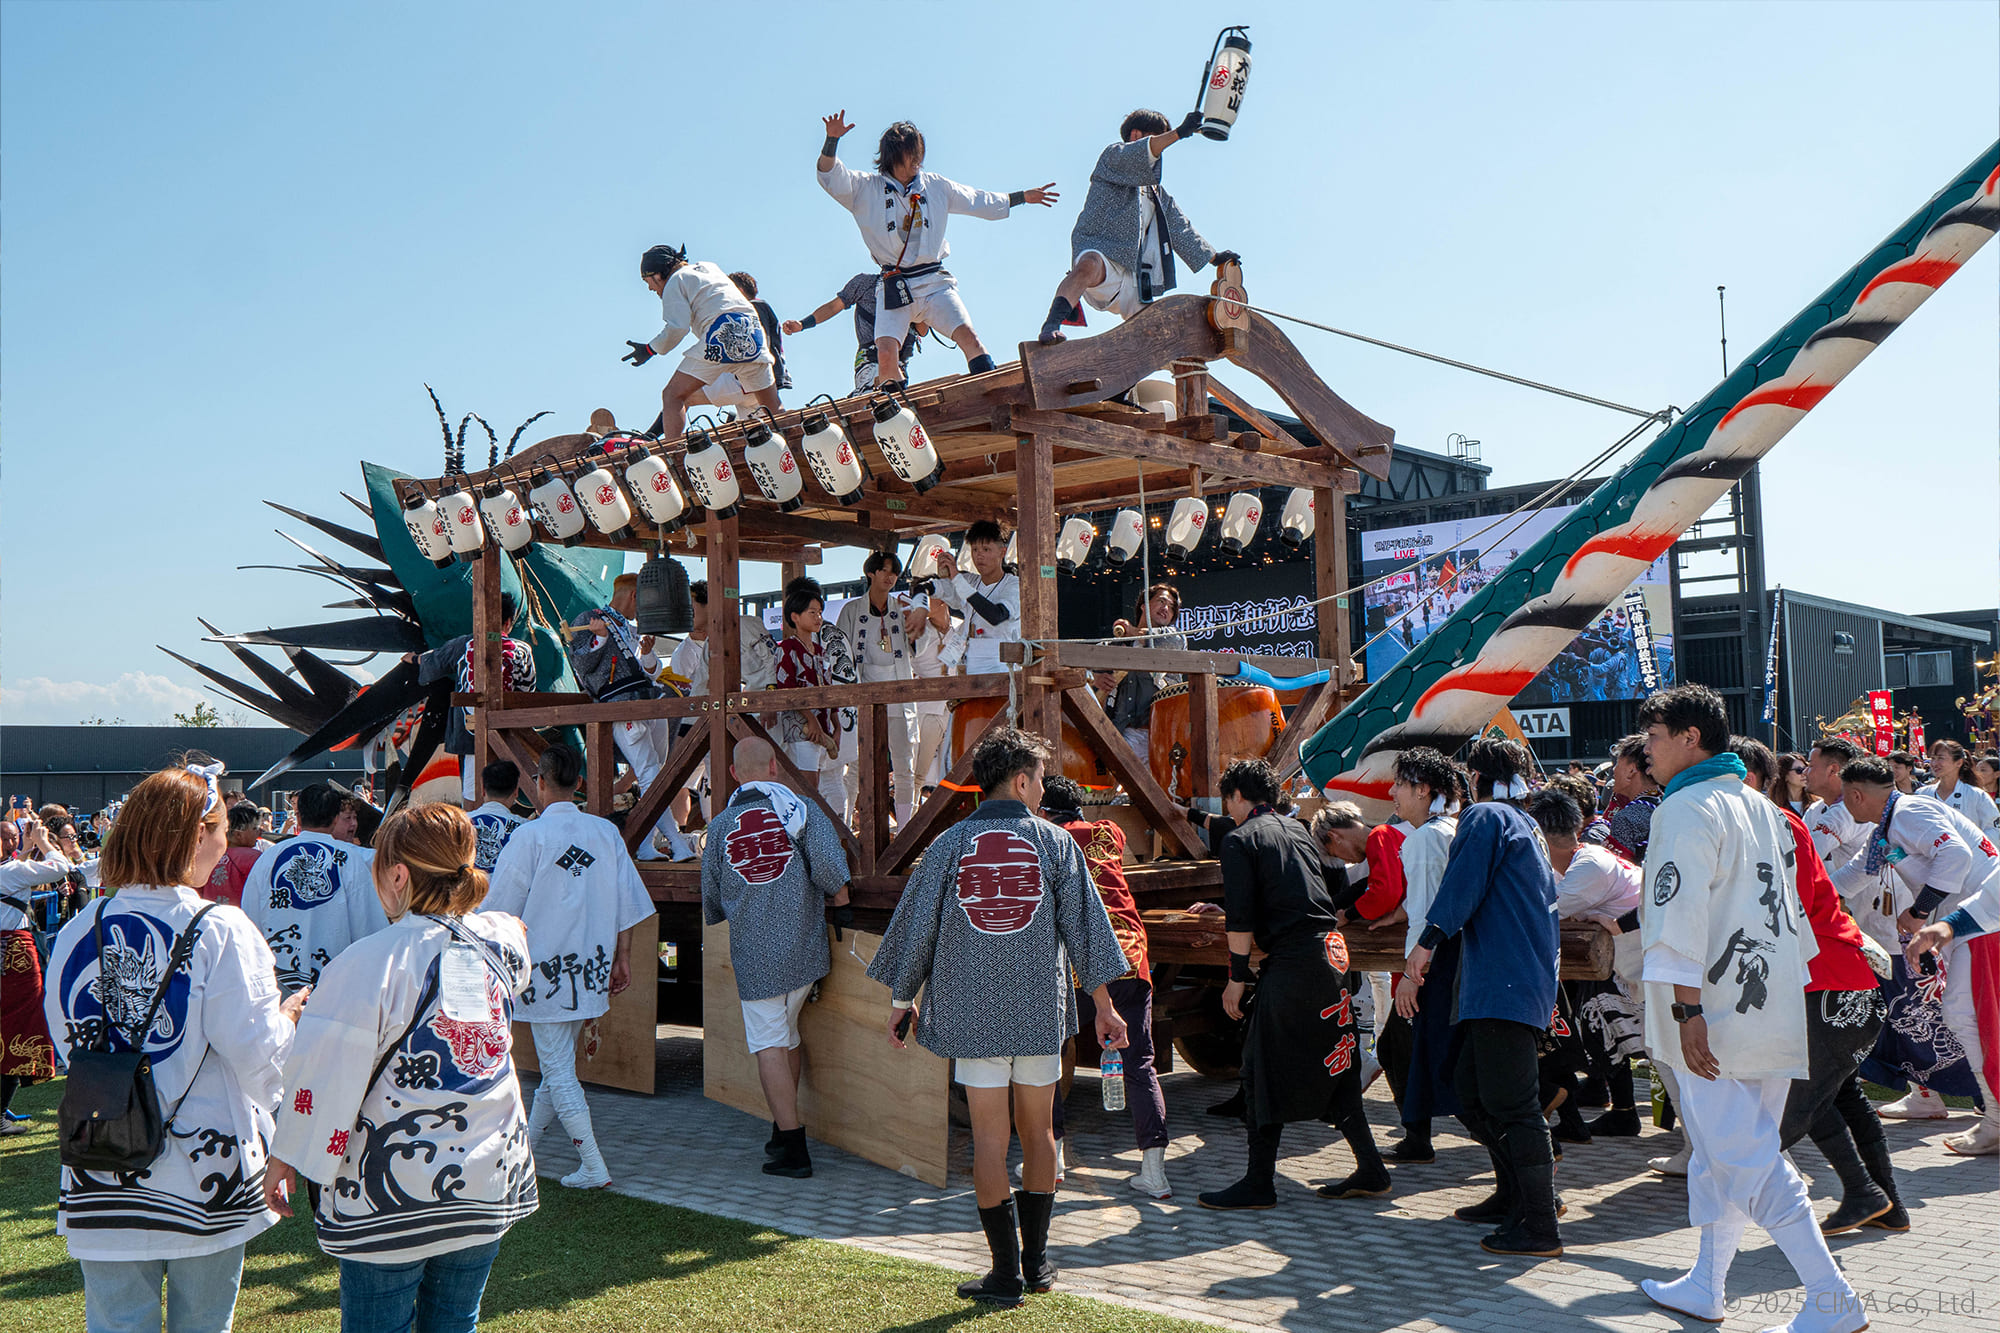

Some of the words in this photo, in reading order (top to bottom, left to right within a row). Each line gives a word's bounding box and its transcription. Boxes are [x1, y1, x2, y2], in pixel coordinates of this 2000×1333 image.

[1227, 57, 1250, 113] 大蛇山
[805, 448, 835, 493] 大蛇山
[815, 450, 836, 482] おおむた
[877, 436, 911, 479] 大蛇山
[889, 435, 911, 468] おおむた
[686, 465, 711, 506] 大蛇山
[749, 460, 777, 500] 大蛇山
[1394, 549, 1415, 560] LIVE
[1176, 595, 1316, 641] 世界平和祈念
[569, 865, 585, 877] 吉
